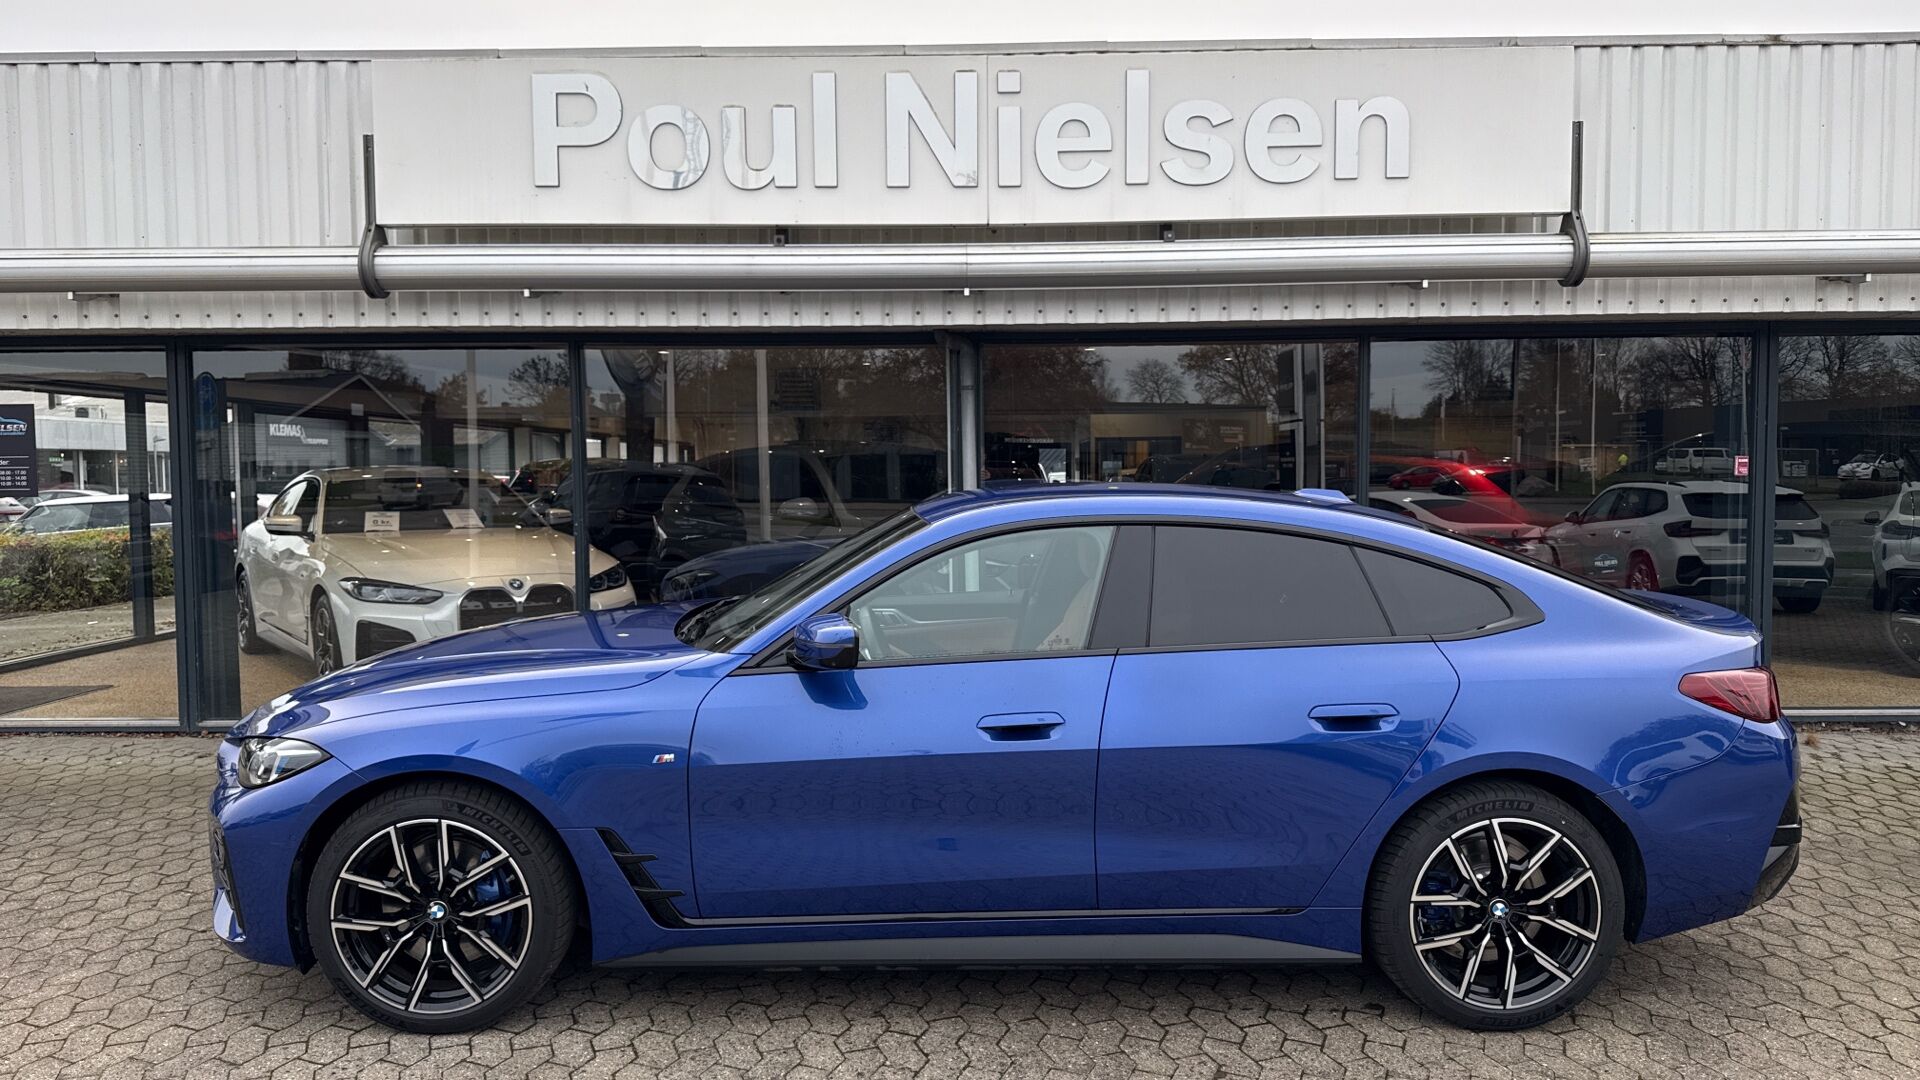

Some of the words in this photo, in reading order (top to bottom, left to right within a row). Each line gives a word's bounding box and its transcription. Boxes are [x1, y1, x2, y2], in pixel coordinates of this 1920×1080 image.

[531, 71, 838, 190] Poul
[885, 69, 1411, 189] Nielsen
[462, 806, 529, 855] MICHELIN
[1456, 801, 1530, 821] MICHELIN
